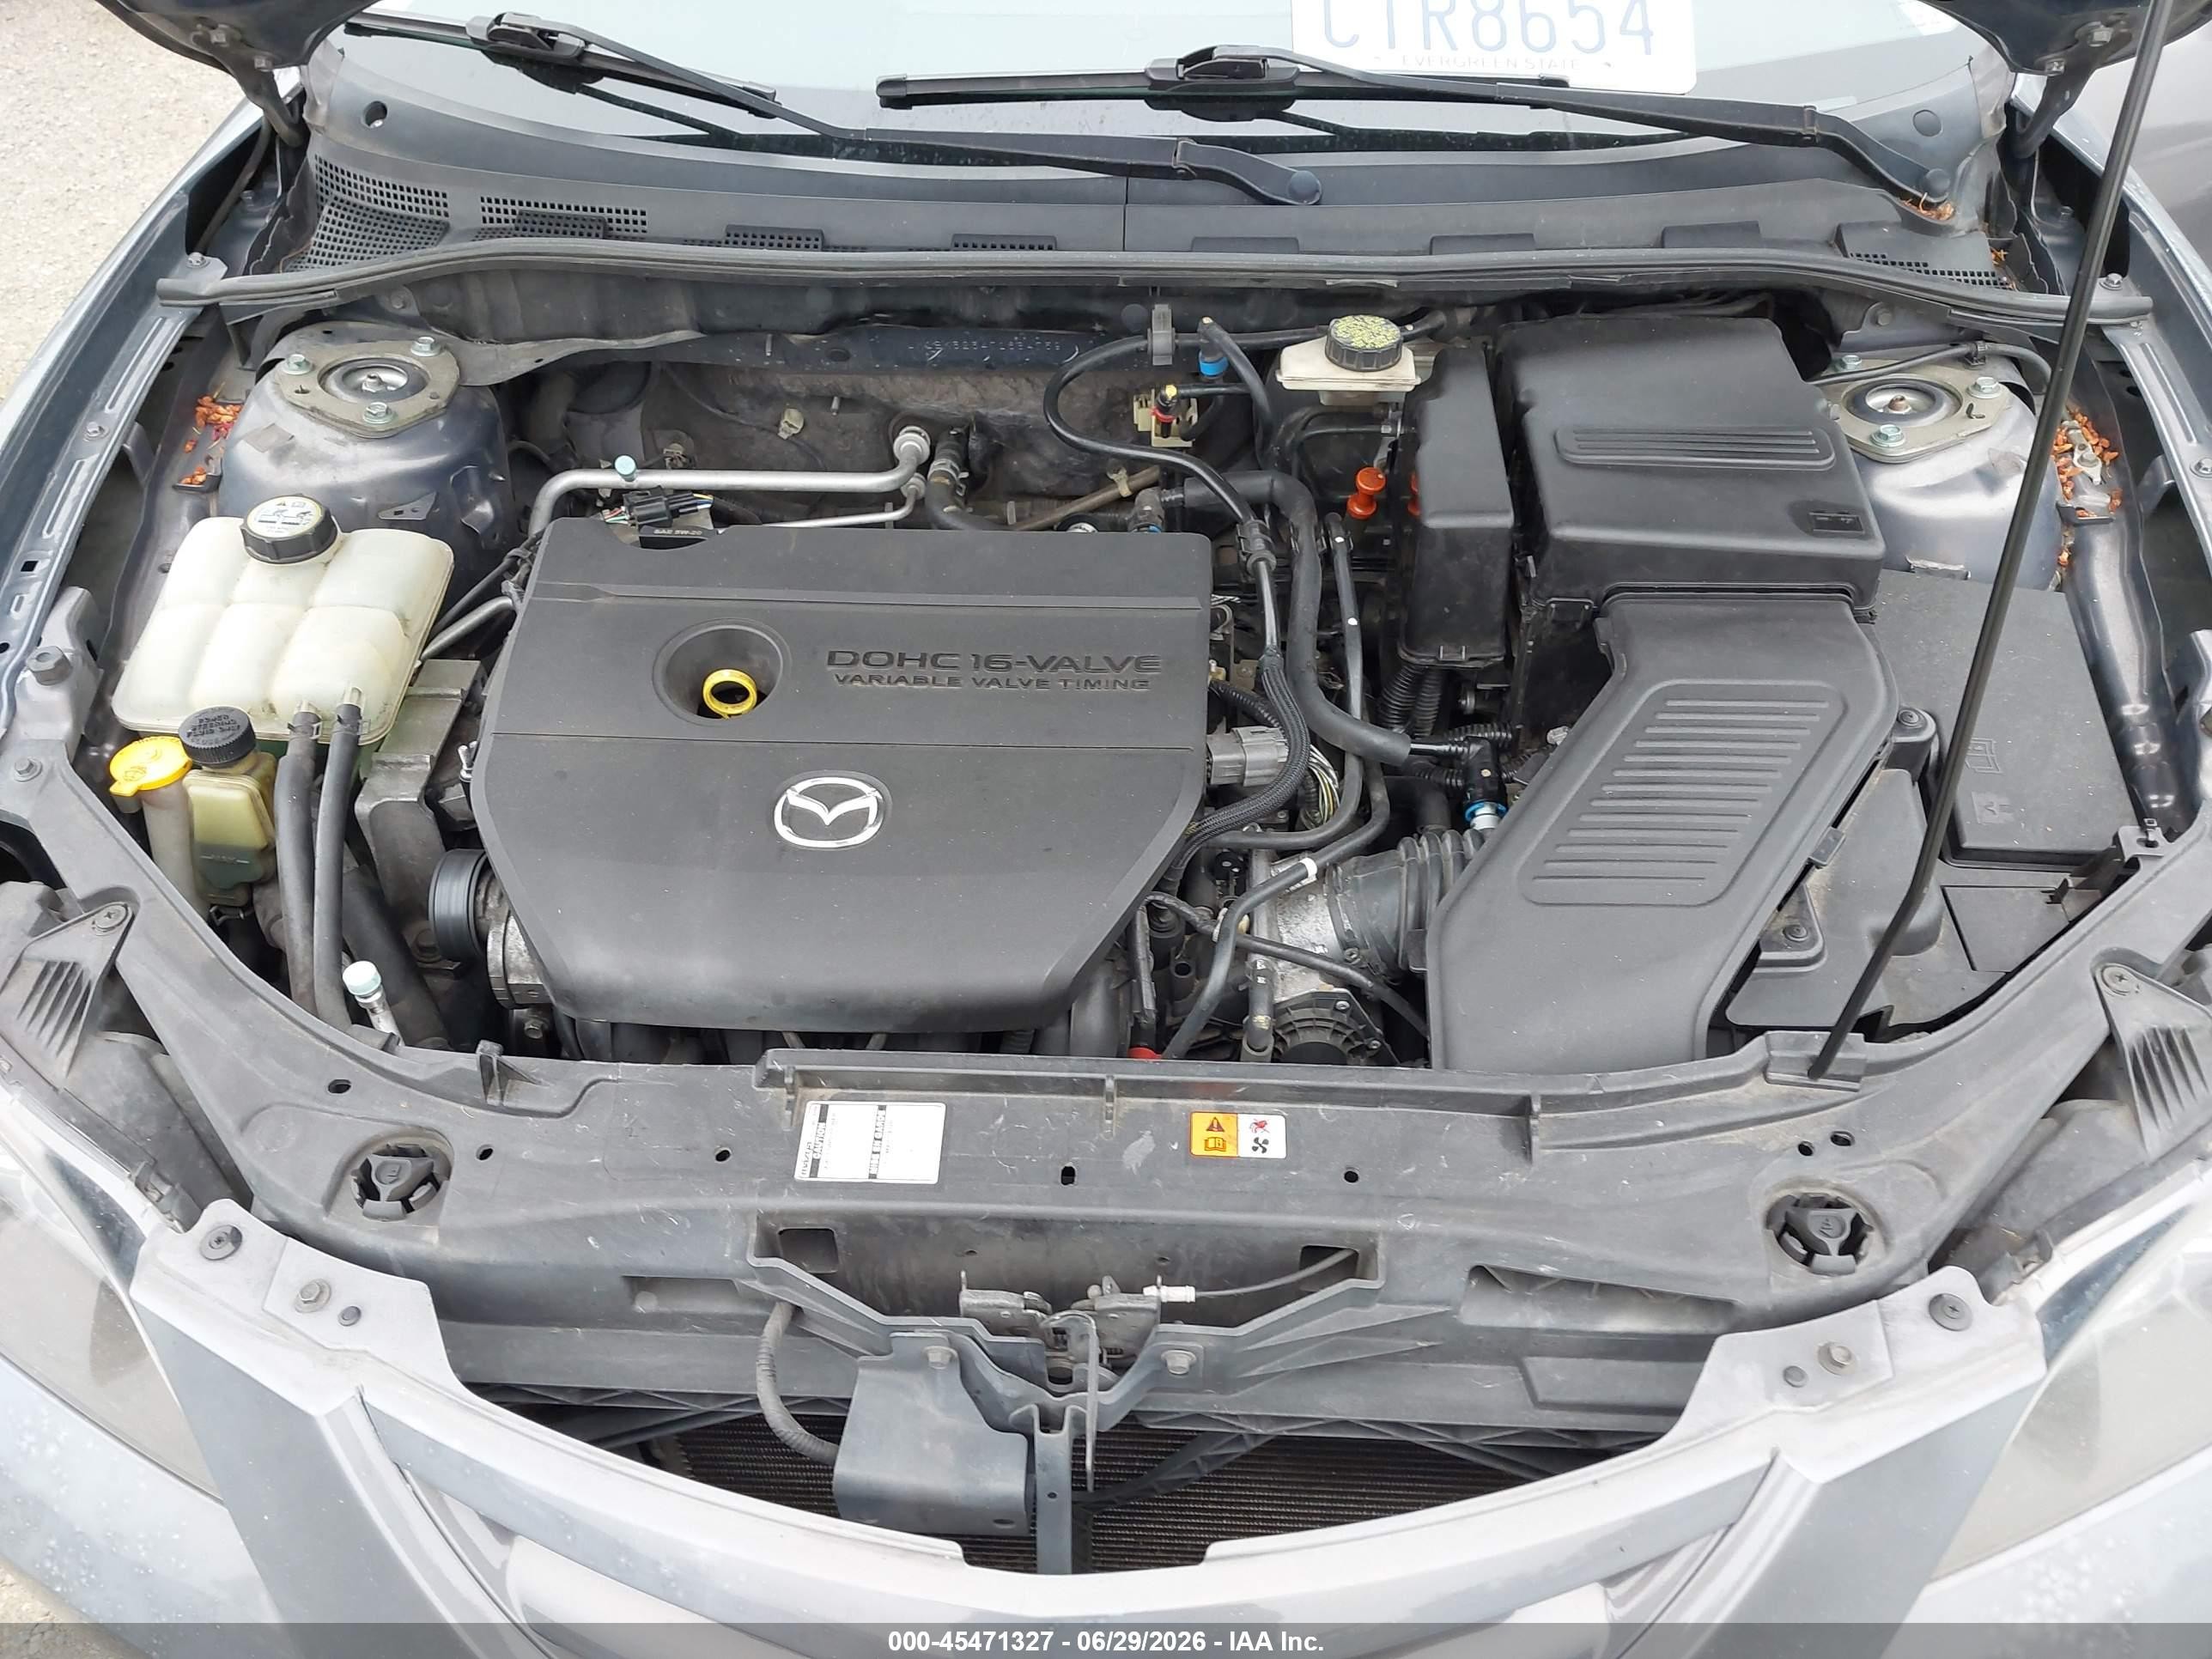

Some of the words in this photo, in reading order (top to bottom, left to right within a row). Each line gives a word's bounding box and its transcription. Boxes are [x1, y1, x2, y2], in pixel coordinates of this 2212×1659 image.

[826, 650, 961, 671] DOHC
[971, 653, 1162, 674] 16-VALVE
[834, 673, 963, 689] VARIABLE
[971, 677, 1051, 690] VALVE
[1059, 678, 1151, 691] TIMING
[812, 1122, 826, 1159] CAUTION
